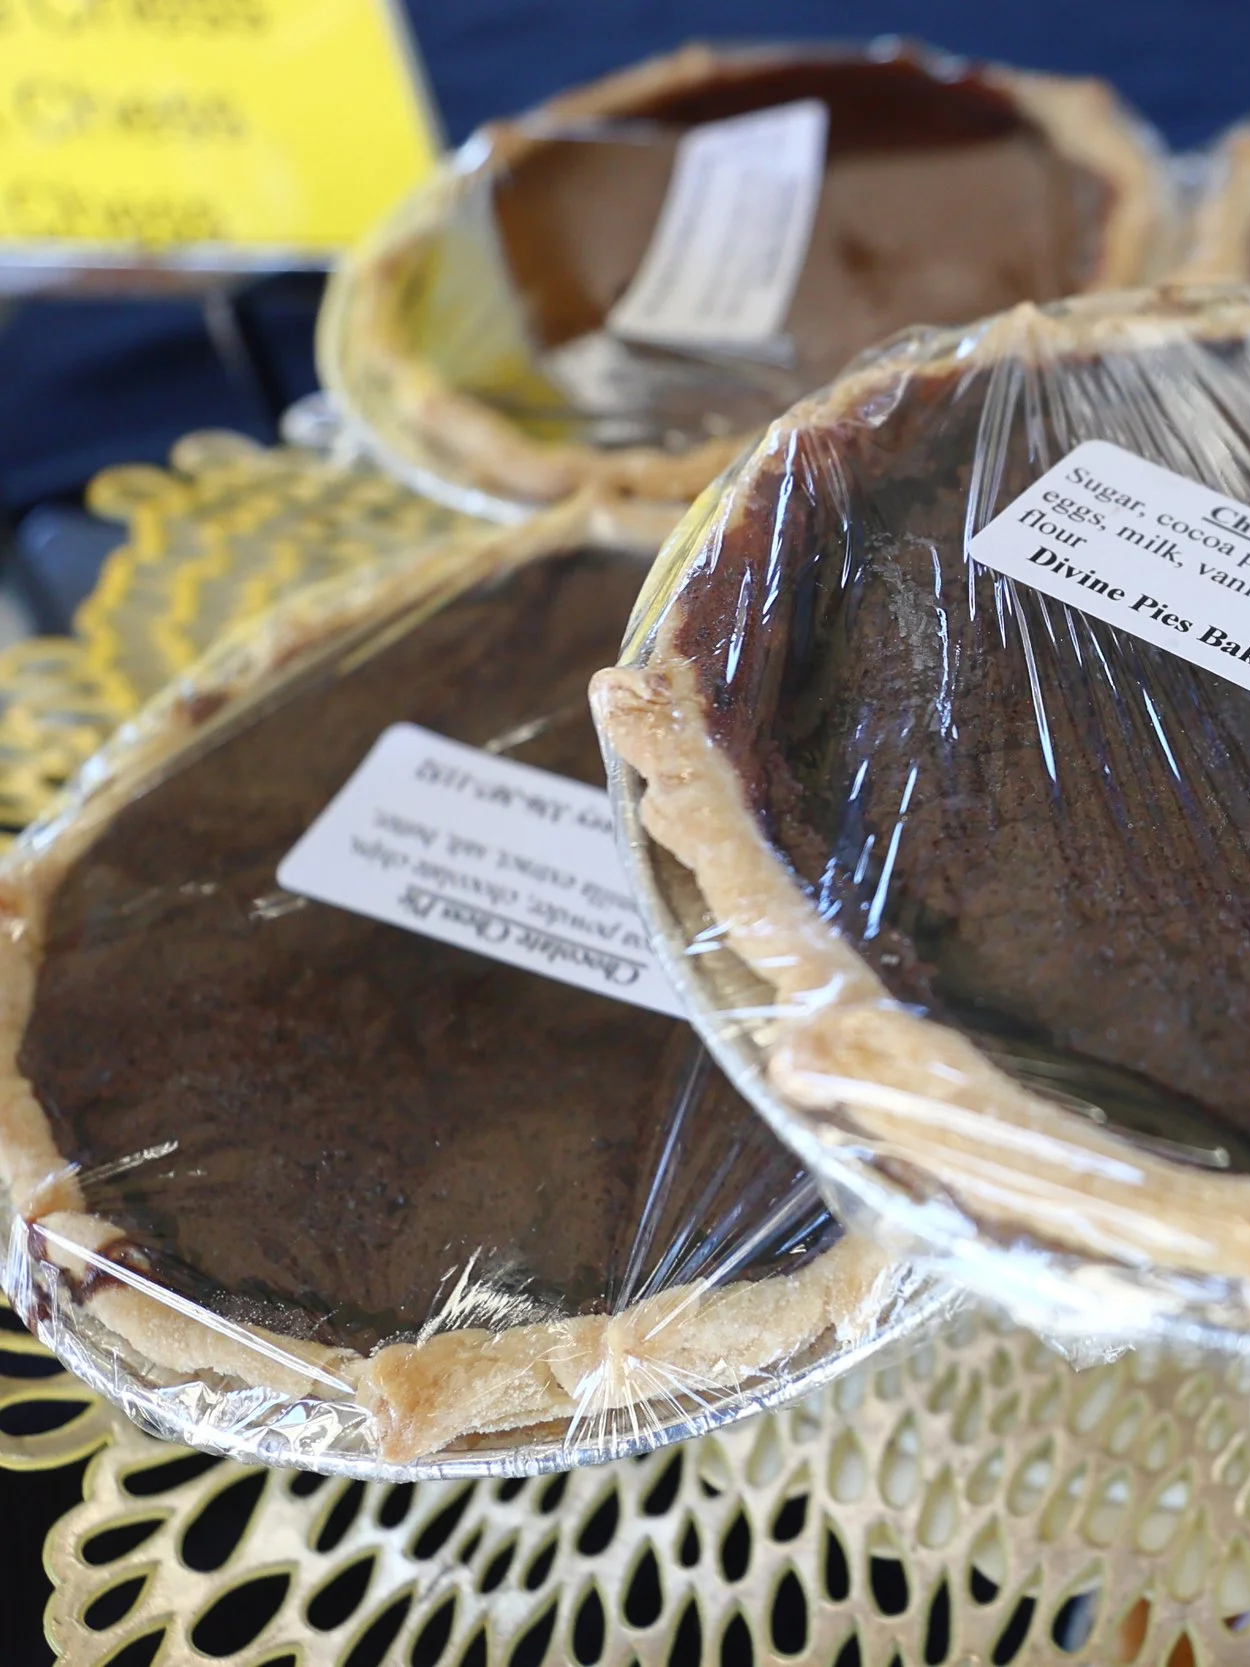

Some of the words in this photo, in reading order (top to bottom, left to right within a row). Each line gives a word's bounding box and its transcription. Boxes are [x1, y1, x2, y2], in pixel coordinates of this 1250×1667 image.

[1019, 508, 1087, 548] flour
[1042, 490, 1106, 532] eggs,
[1117, 524, 1184, 568] milk,
[1065, 468, 1145, 519] Sugar,
[1157, 512, 1234, 555] cocoa
[1027, 546, 1125, 602] Divine
[1128, 594, 1193, 633] Pies
[441, 905, 511, 942] Chess
[516, 930, 641, 985] Chocolate
